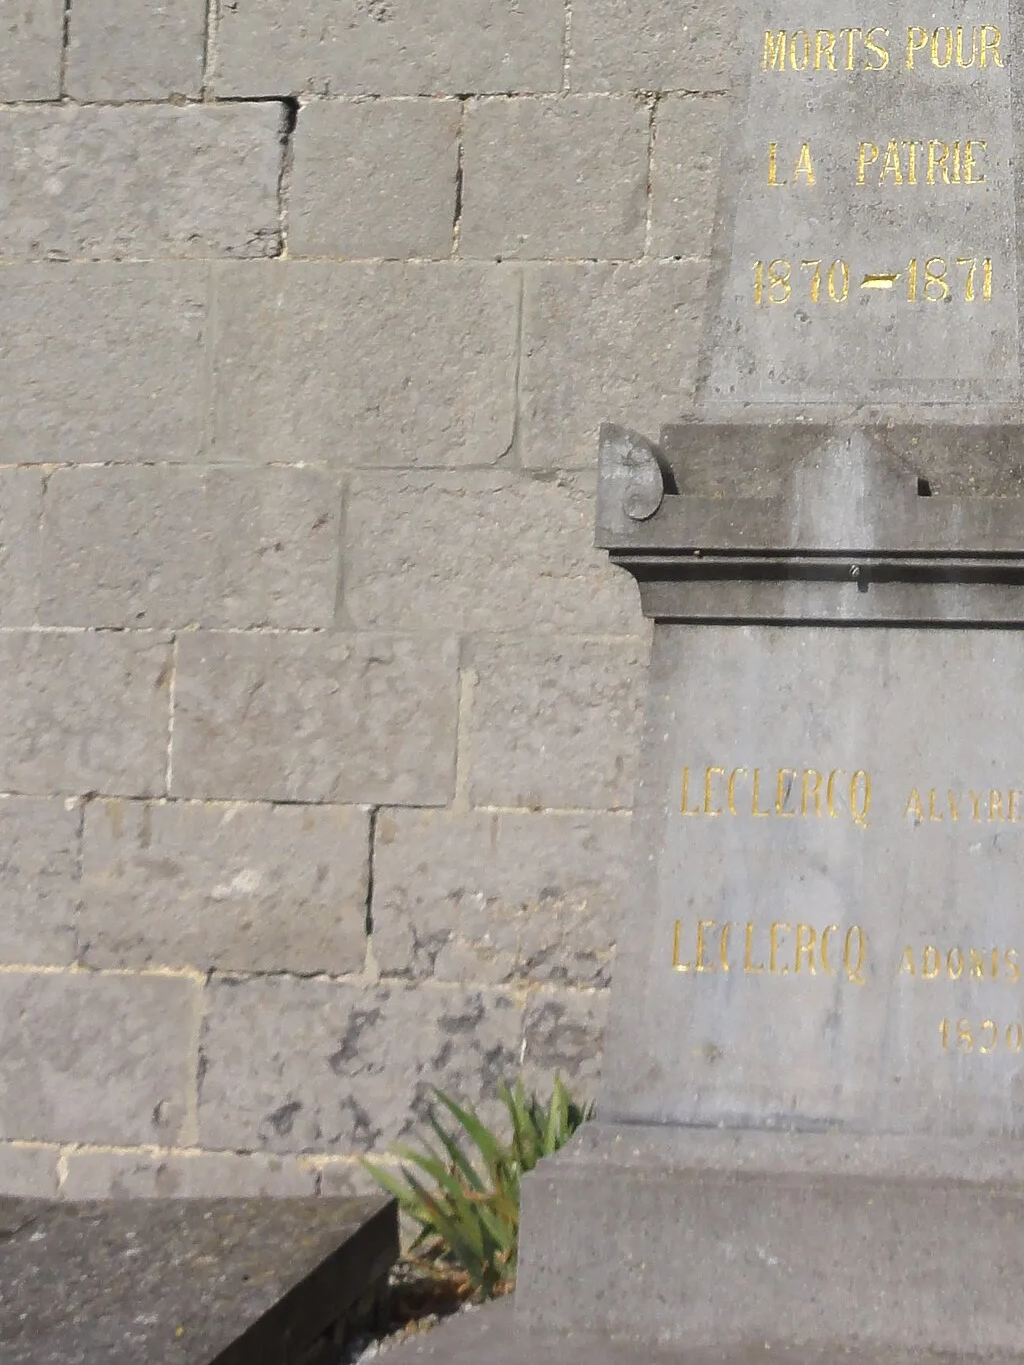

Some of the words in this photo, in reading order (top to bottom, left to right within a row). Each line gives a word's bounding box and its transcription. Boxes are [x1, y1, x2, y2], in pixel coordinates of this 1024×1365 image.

[762, 25, 890, 72] MORTS
[905, 24, 1005, 70] POUR
[767, 140, 817, 187] LA
[855, 138, 988, 186] PATRIE
[679, 764, 873, 829] LECLERCQ
[902, 786, 1024, 824] ALVYRE
[671, 919, 868, 986] LECLERCQ
[897, 943, 1022, 984] ADONIS
